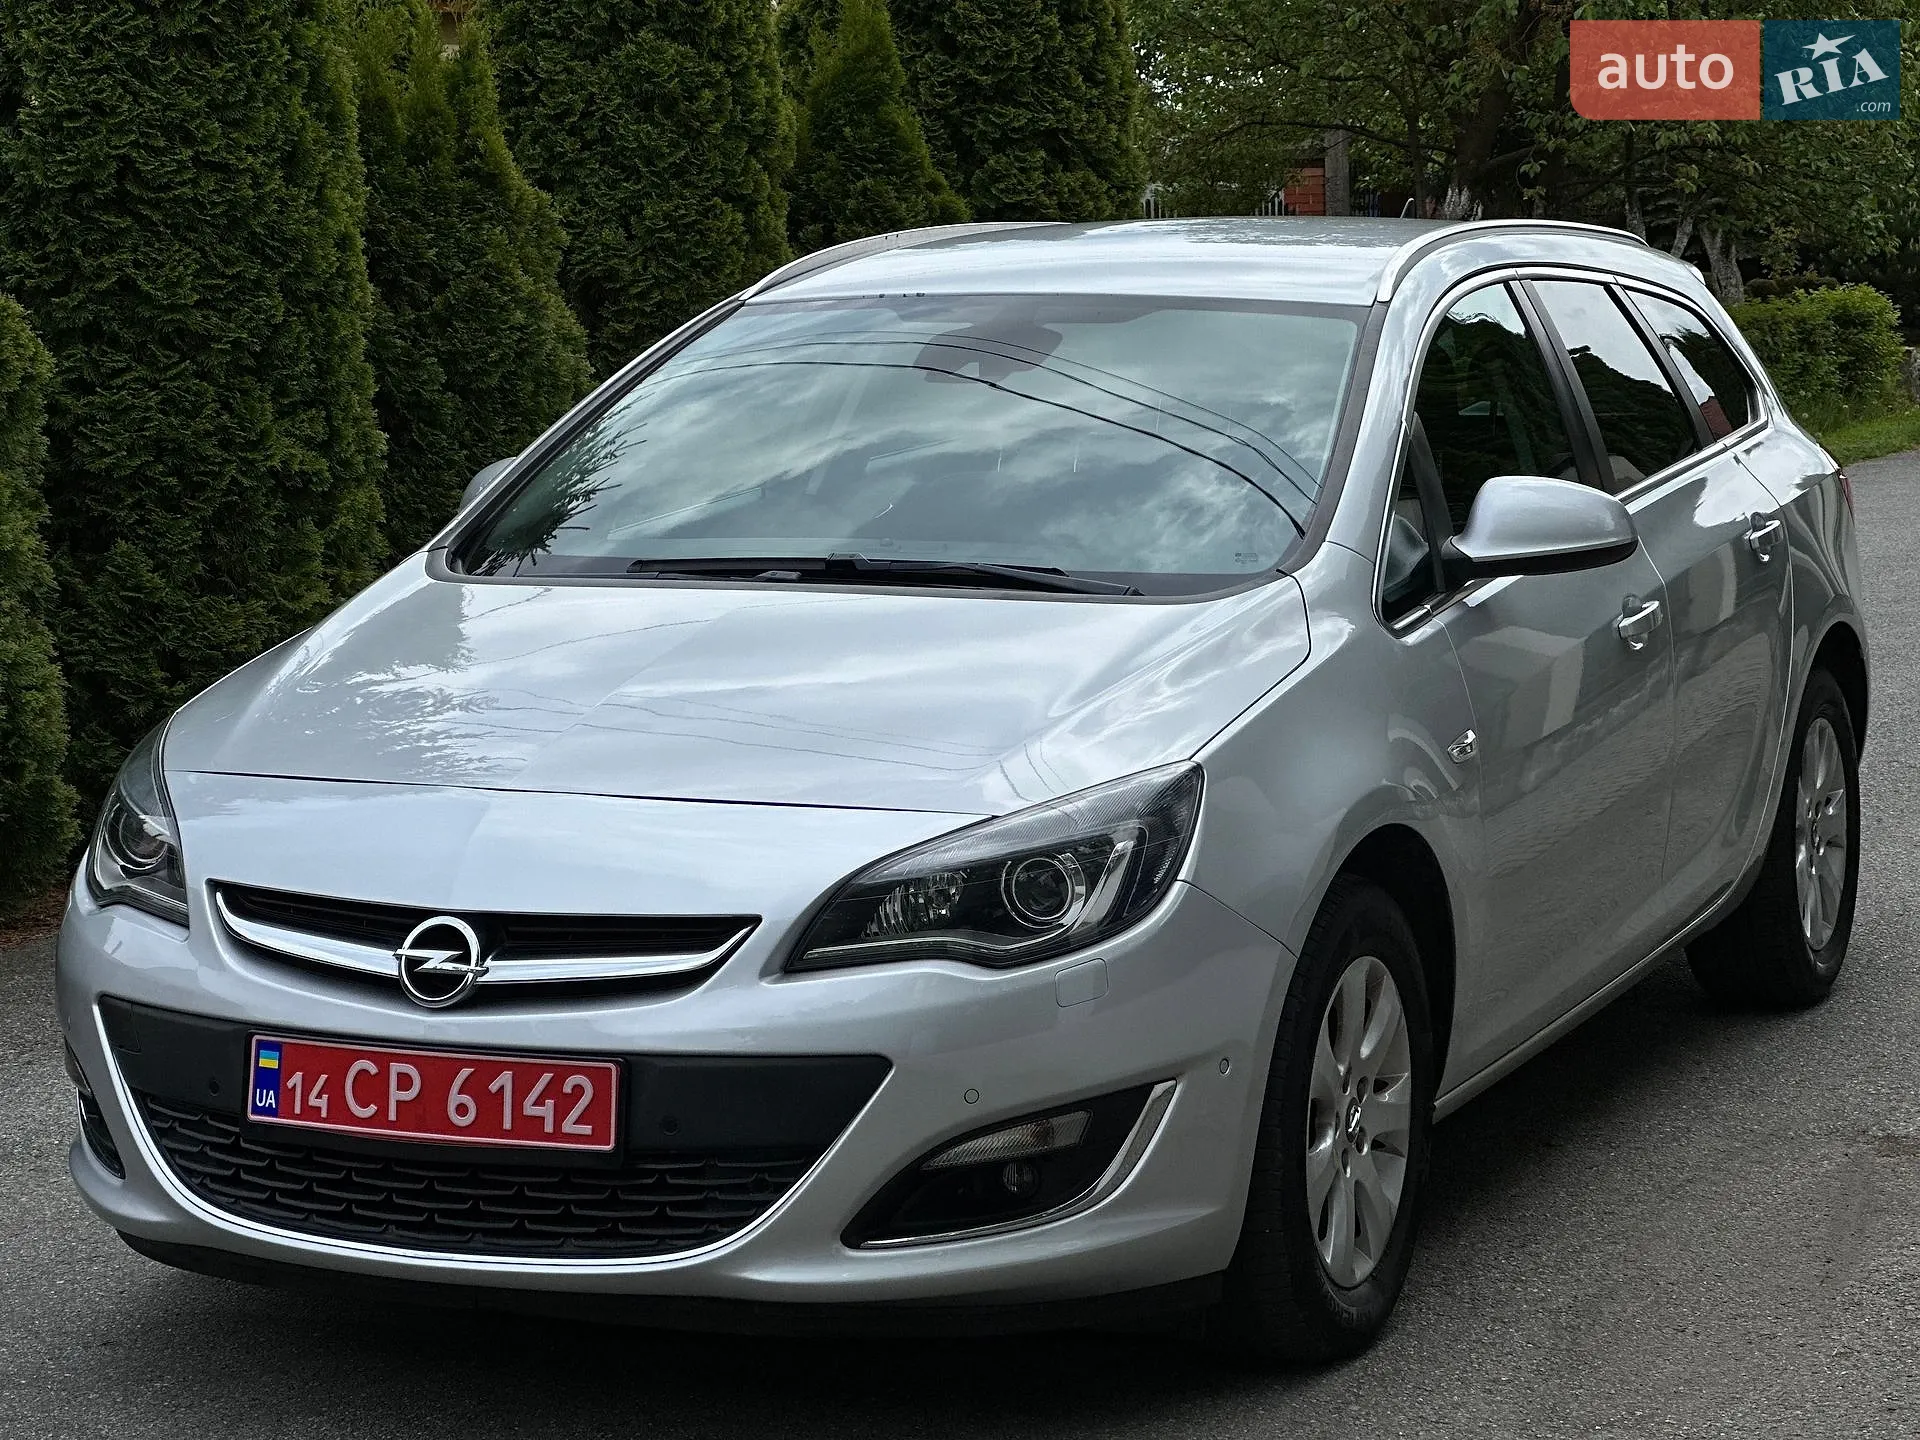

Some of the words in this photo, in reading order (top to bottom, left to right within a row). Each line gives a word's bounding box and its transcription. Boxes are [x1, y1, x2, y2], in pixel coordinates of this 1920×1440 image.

[256, 1088, 276, 1108] UA
[286, 1071, 328, 1118] 14
[344, 1059, 422, 1121] CP
[447, 1068, 595, 1135] 6142
